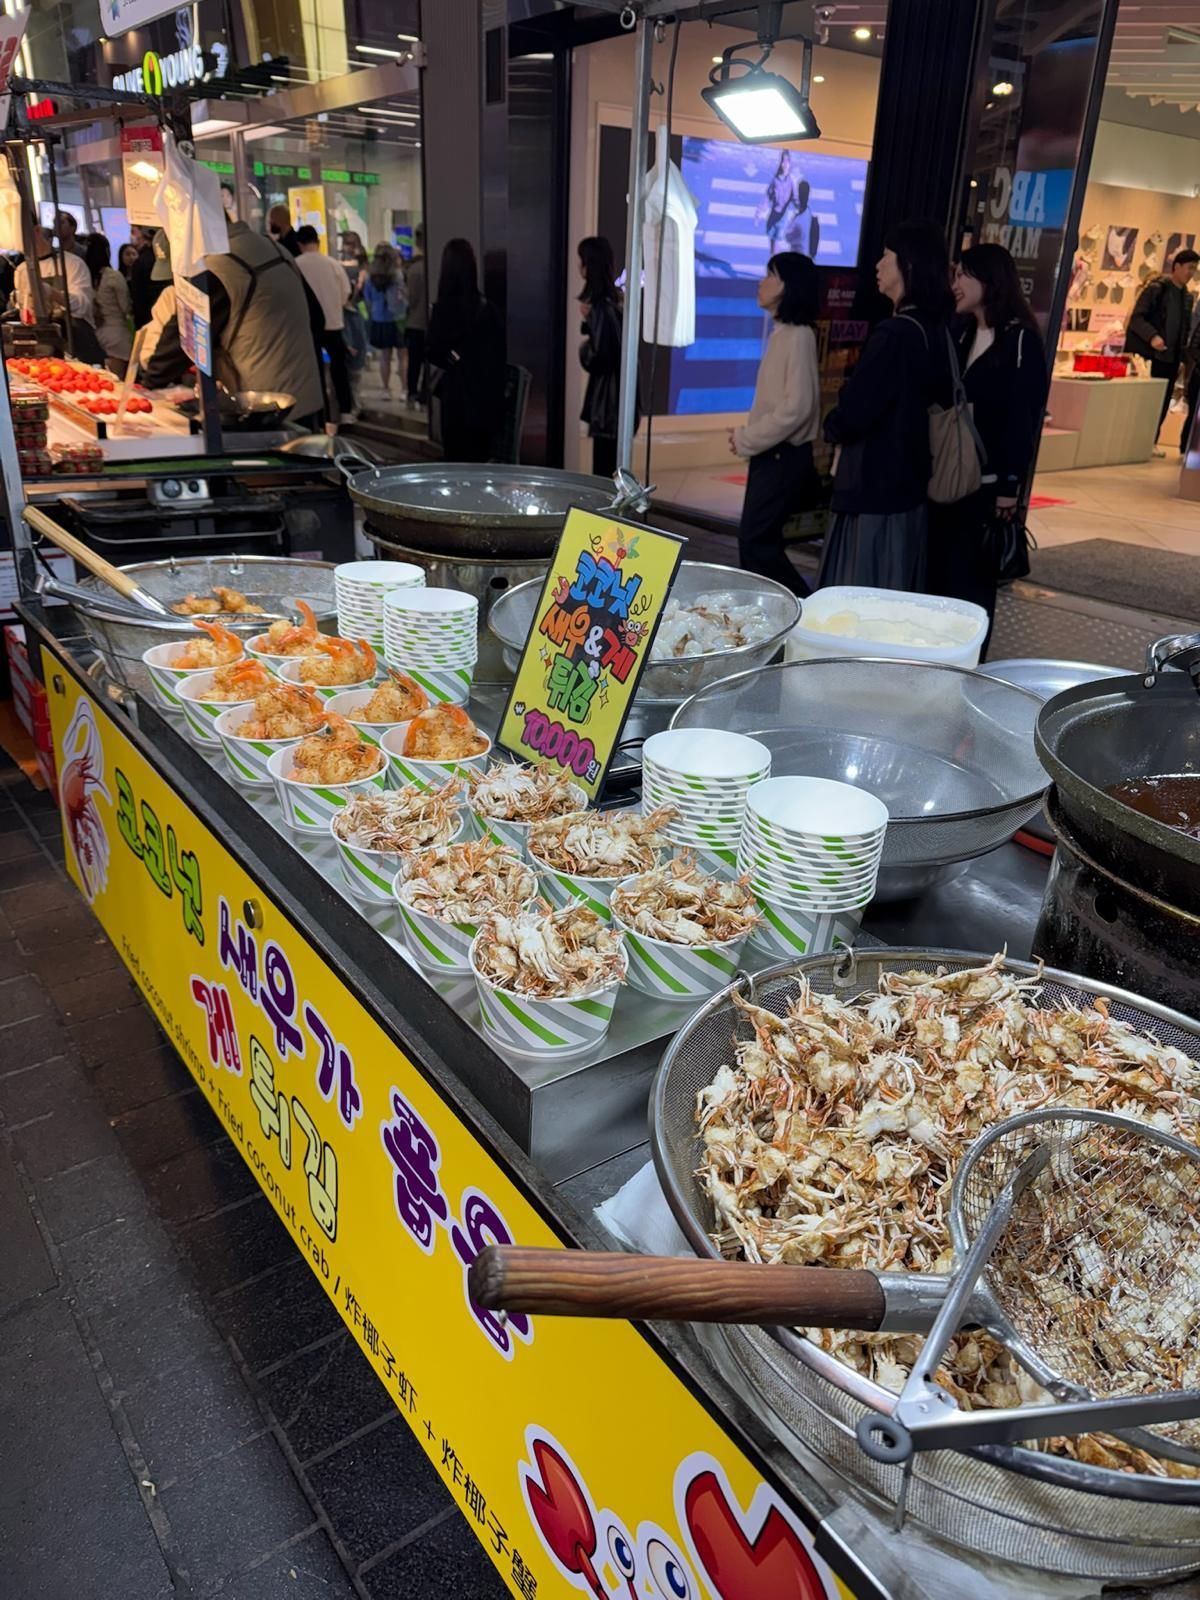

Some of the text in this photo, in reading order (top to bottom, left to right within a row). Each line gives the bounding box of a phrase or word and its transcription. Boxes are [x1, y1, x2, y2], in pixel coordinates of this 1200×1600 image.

[158, 44, 204, 88] YOUNG
[570, 550, 642, 619] 코코넛
[547, 653, 600, 724] 튀김
[115, 767, 204, 946] 코코넛
[219, 898, 362, 1127] 새우가
[250, 1034, 338, 1243] 튀김
[175, 1023, 206, 1082] shrimp
[218, 1089, 244, 1142] Fried
[247, 1140, 297, 1229] coconut
[300, 1224, 330, 1279] crab
[344, 1286, 418, 1414] 炸椰子虾
